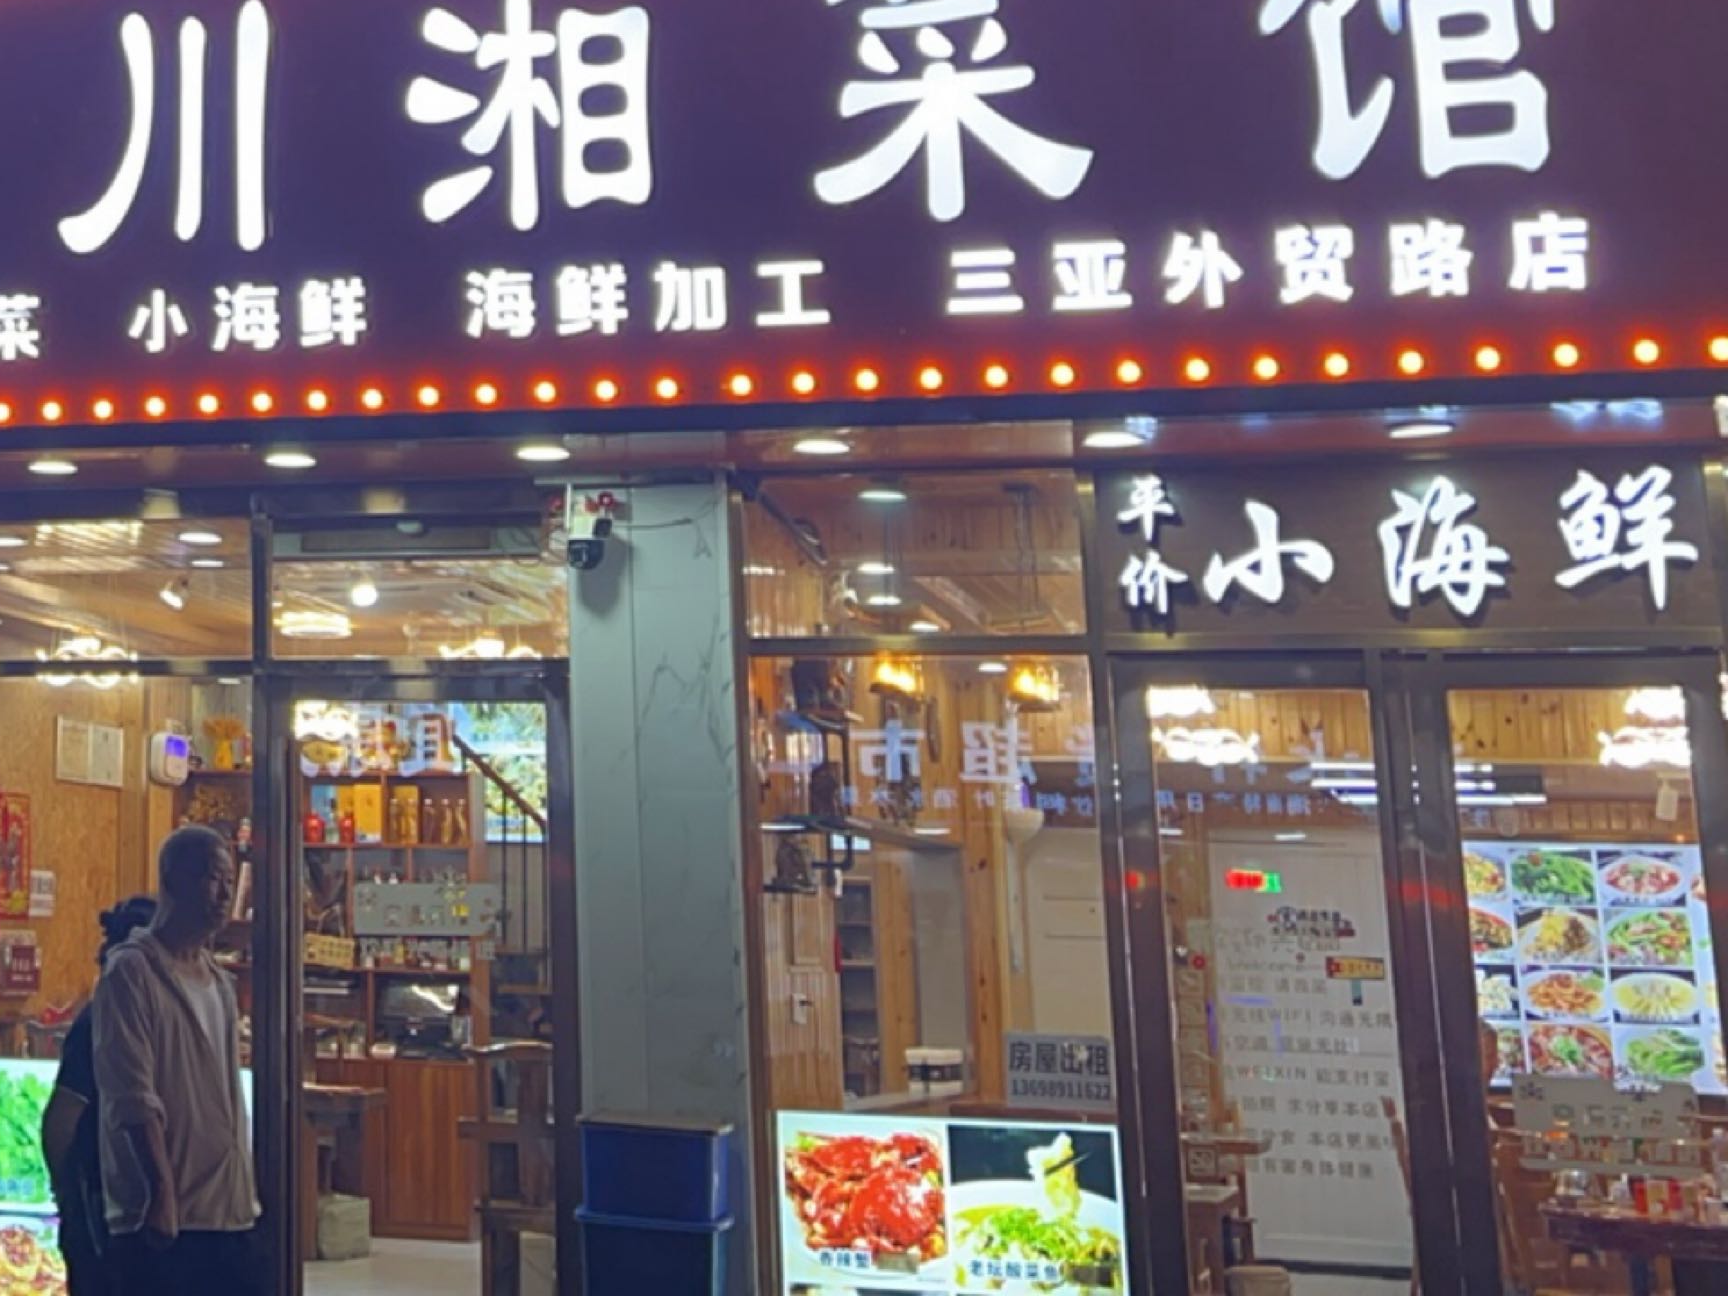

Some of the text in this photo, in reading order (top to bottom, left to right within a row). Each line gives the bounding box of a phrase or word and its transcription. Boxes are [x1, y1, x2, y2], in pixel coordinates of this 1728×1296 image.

[128, 278, 368, 353] 小海鲜
[466, 260, 832, 337] 海鲜加工
[947, 212, 1589, 315] 三亚外贸路店
[1116, 474, 1189, 615] 平价
[1202, 464, 1700, 616] 小海鲜
[1007, 1039, 1112, 1077] 房屋出租
